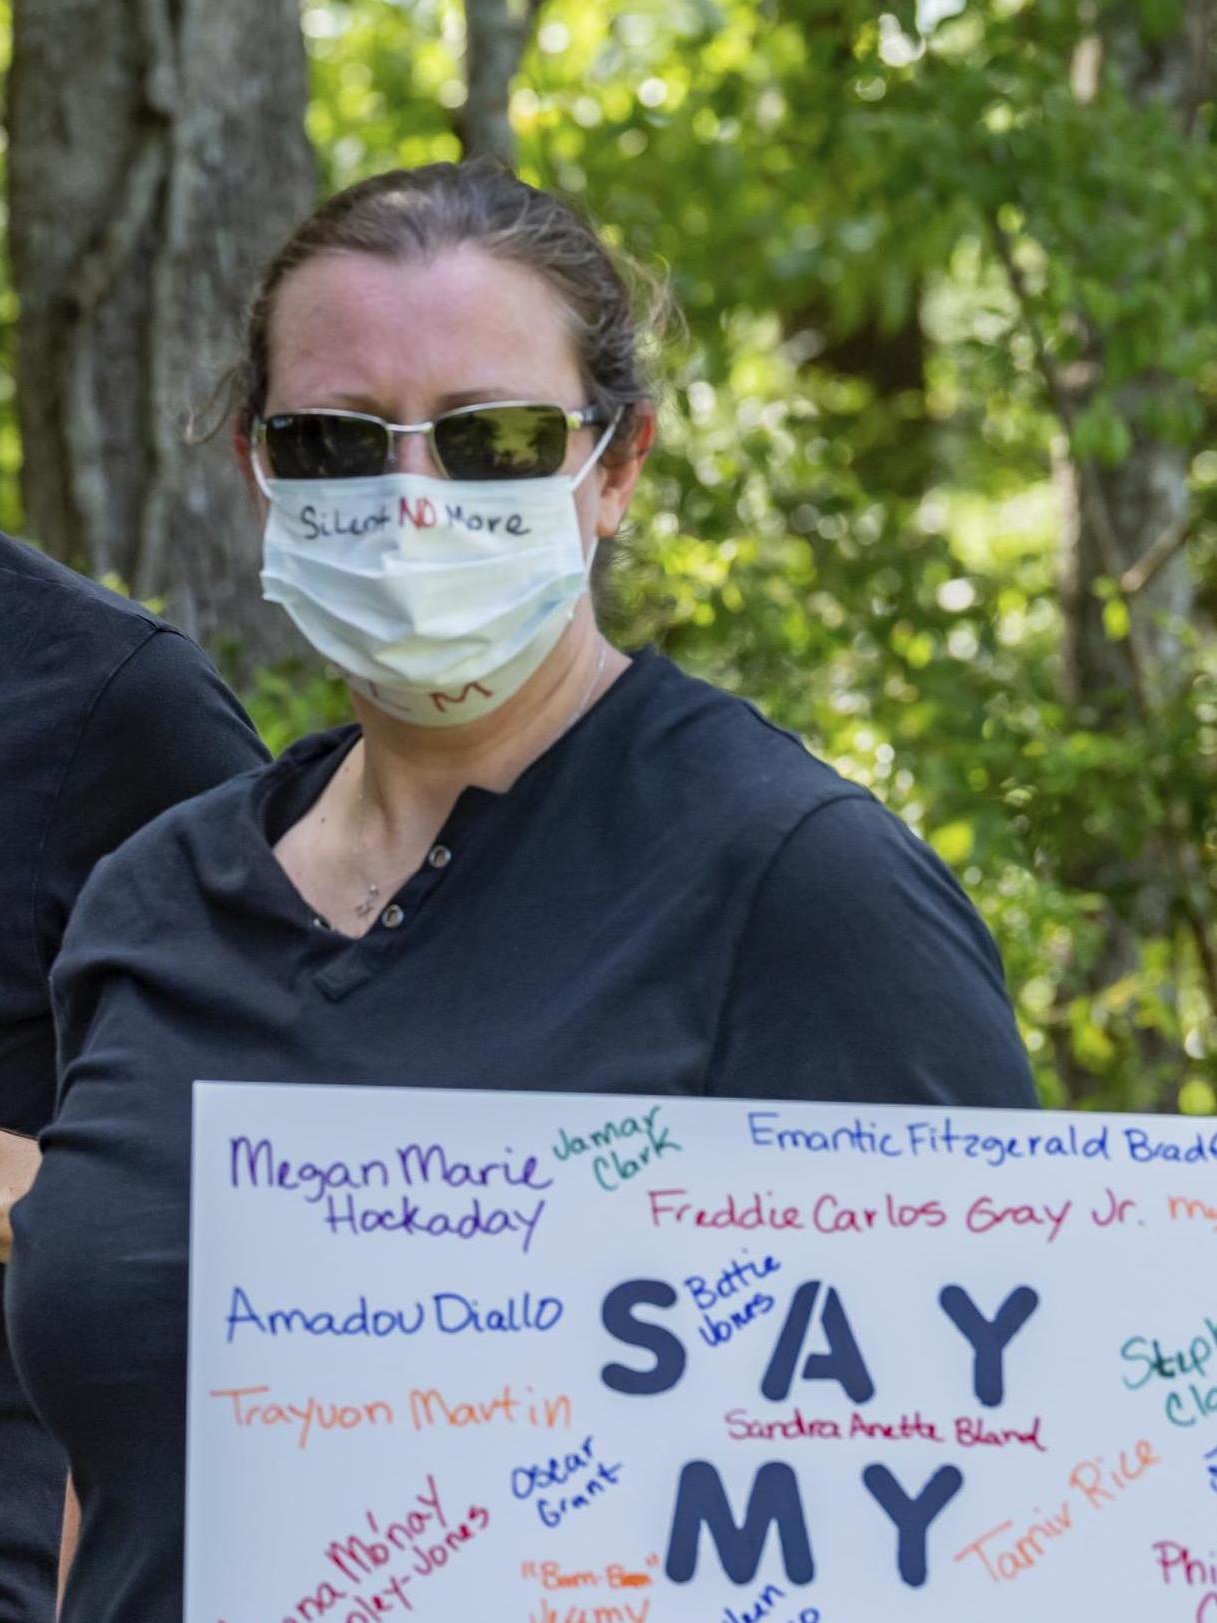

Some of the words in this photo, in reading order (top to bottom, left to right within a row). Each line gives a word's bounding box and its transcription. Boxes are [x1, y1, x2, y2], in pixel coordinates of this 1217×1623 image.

[552, 1105, 661, 1161] Jamar
[592, 1126, 682, 1191] Clark
[906, 1118, 1110, 1168] Fitzgerald
[229, 1136, 389, 1204] Megan
[395, 1142, 555, 1190] Marie
[324, 1195, 546, 1254] Hockaday
[647, 1188, 804, 1231] Freddie
[812, 1193, 947, 1234] Carlos
[964, 1195, 1073, 1243] Gray
[1091, 1187, 1145, 1228] Jr.
[431, 1291, 564, 1335] Diallo
[600, 1277, 1041, 1408] SAY
[409, 1386, 573, 1431] Martin
[724, 1408, 841, 1440] Sandra
[954, 1416, 1047, 1452] Bland
[511, 1435, 594, 1500] Oscar
[537, 1461, 624, 1528] Grant
[1069, 1439, 1162, 1510] Rice
[665, 1460, 964, 1588] MY
